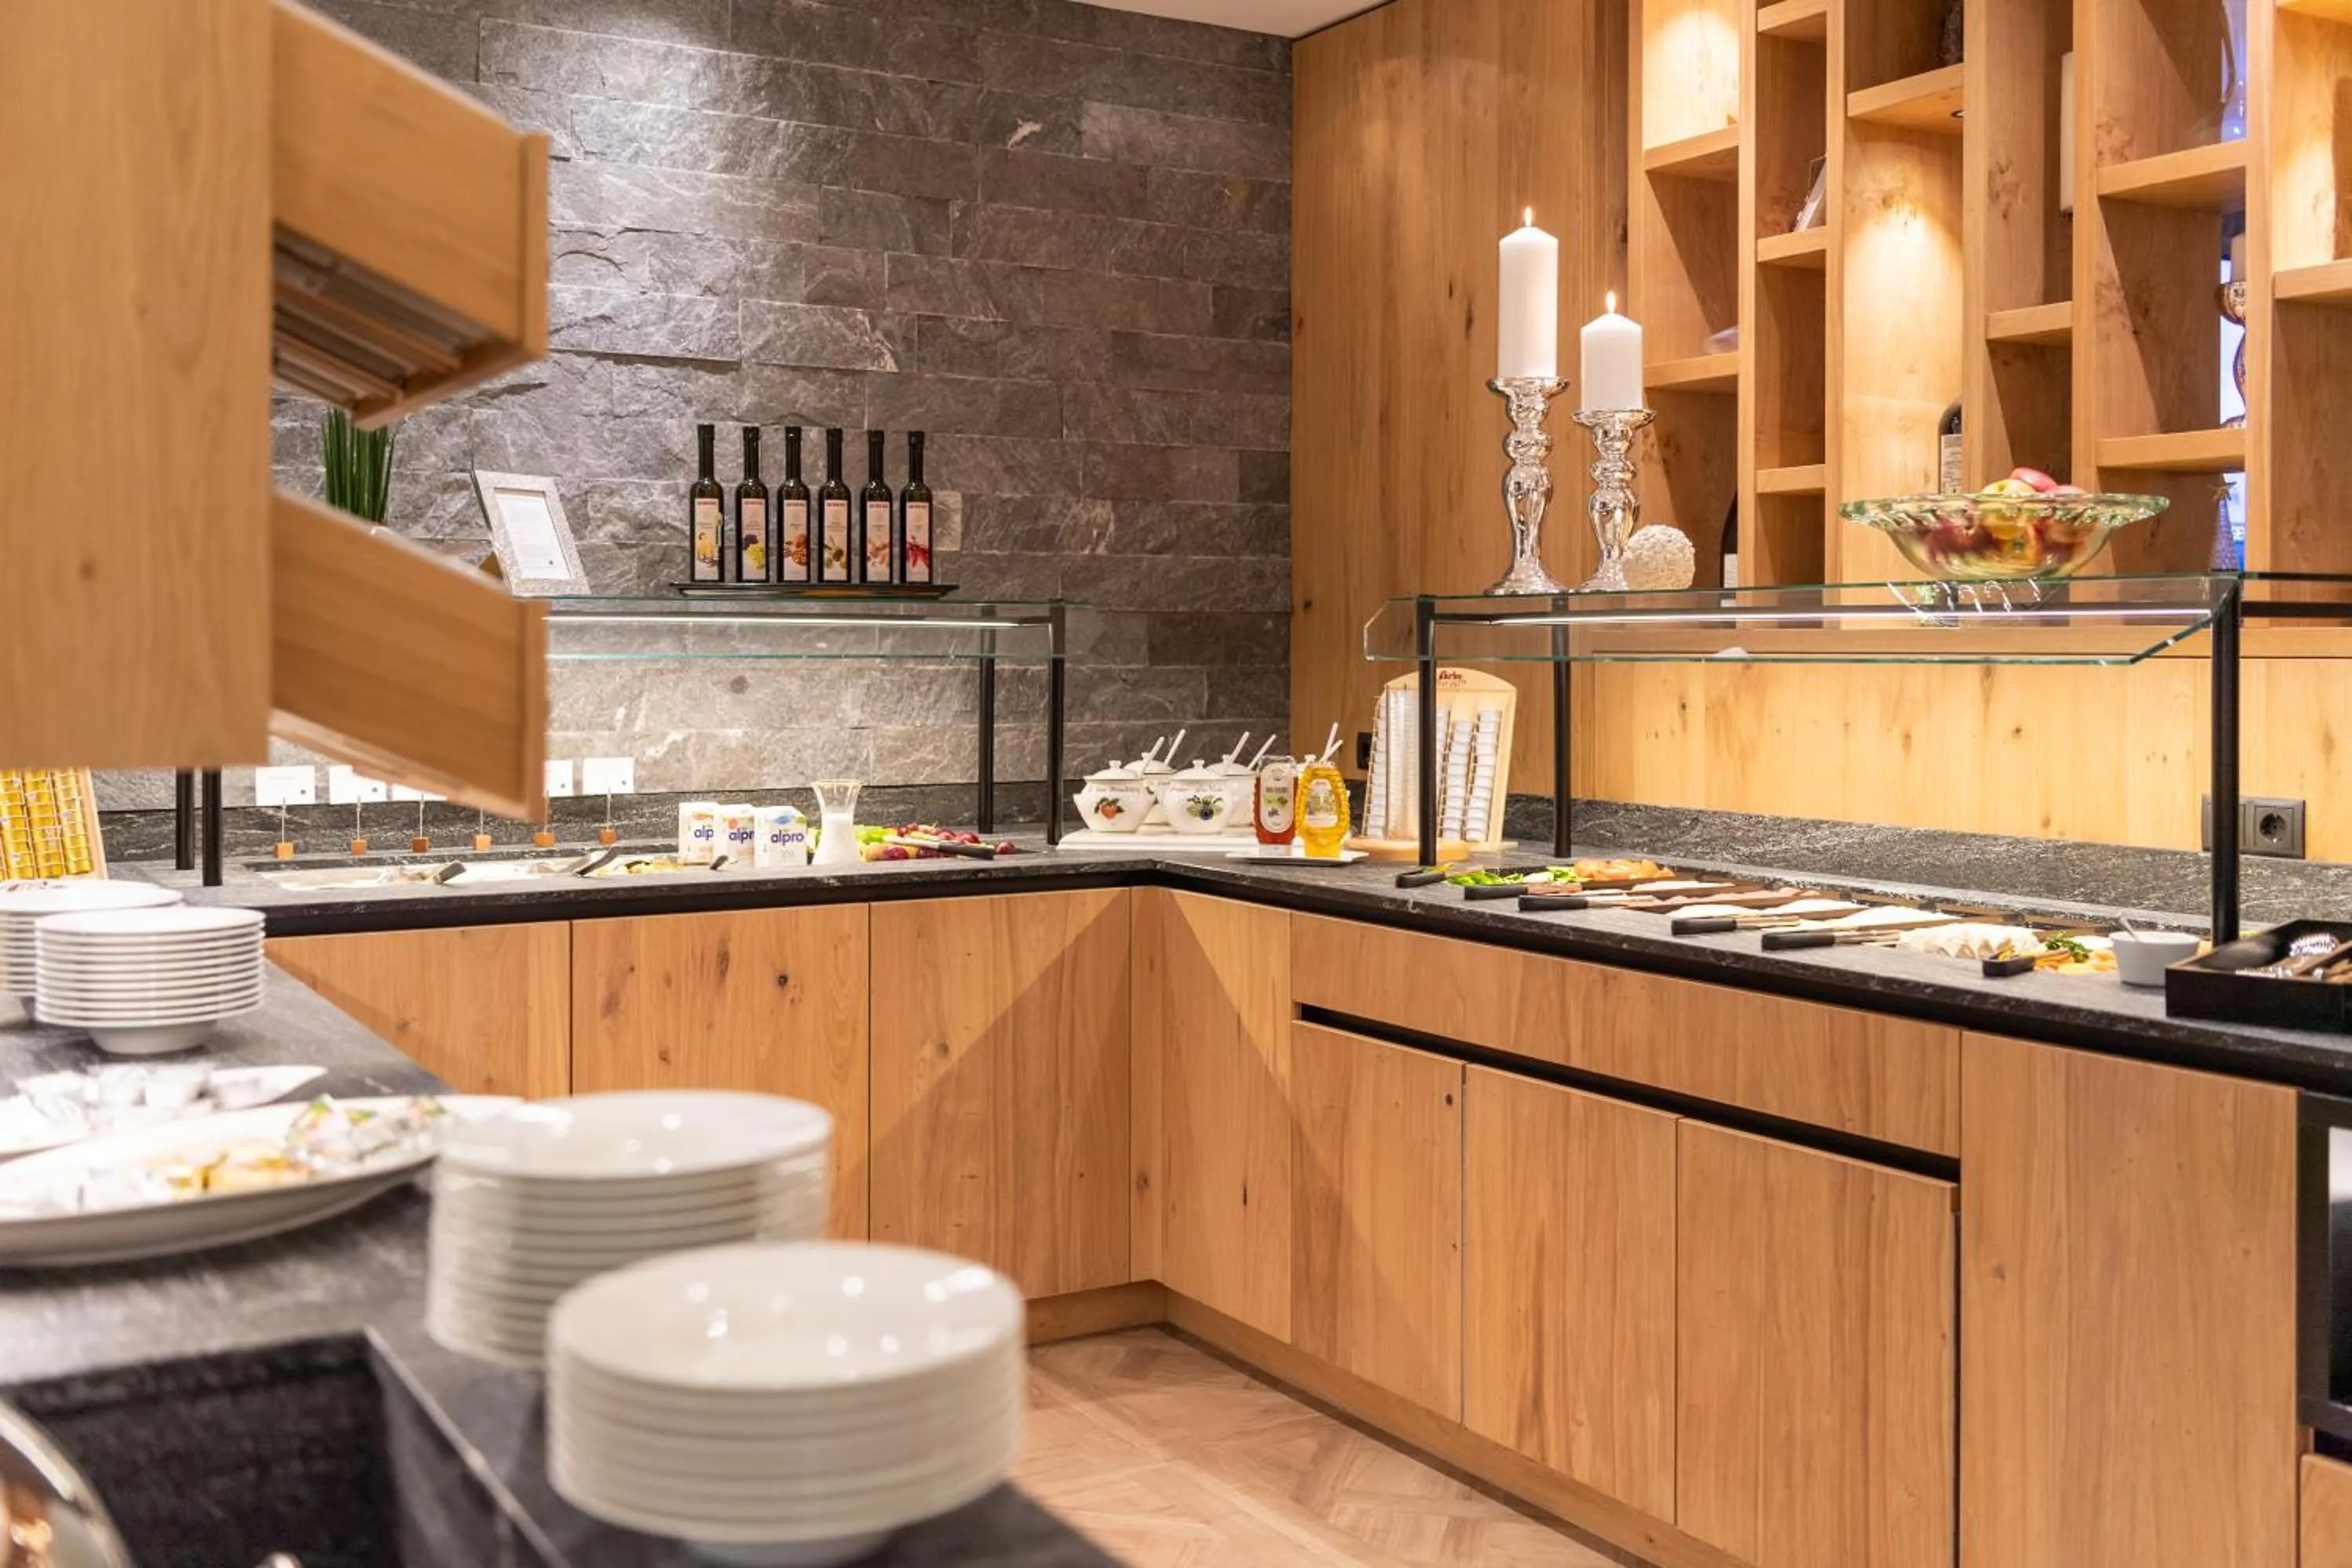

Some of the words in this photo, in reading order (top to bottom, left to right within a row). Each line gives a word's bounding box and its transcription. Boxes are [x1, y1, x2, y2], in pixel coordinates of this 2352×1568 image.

[694, 825, 714, 841] alp
[728, 828, 754, 844] alpr
[771, 829, 805, 846] alpro
